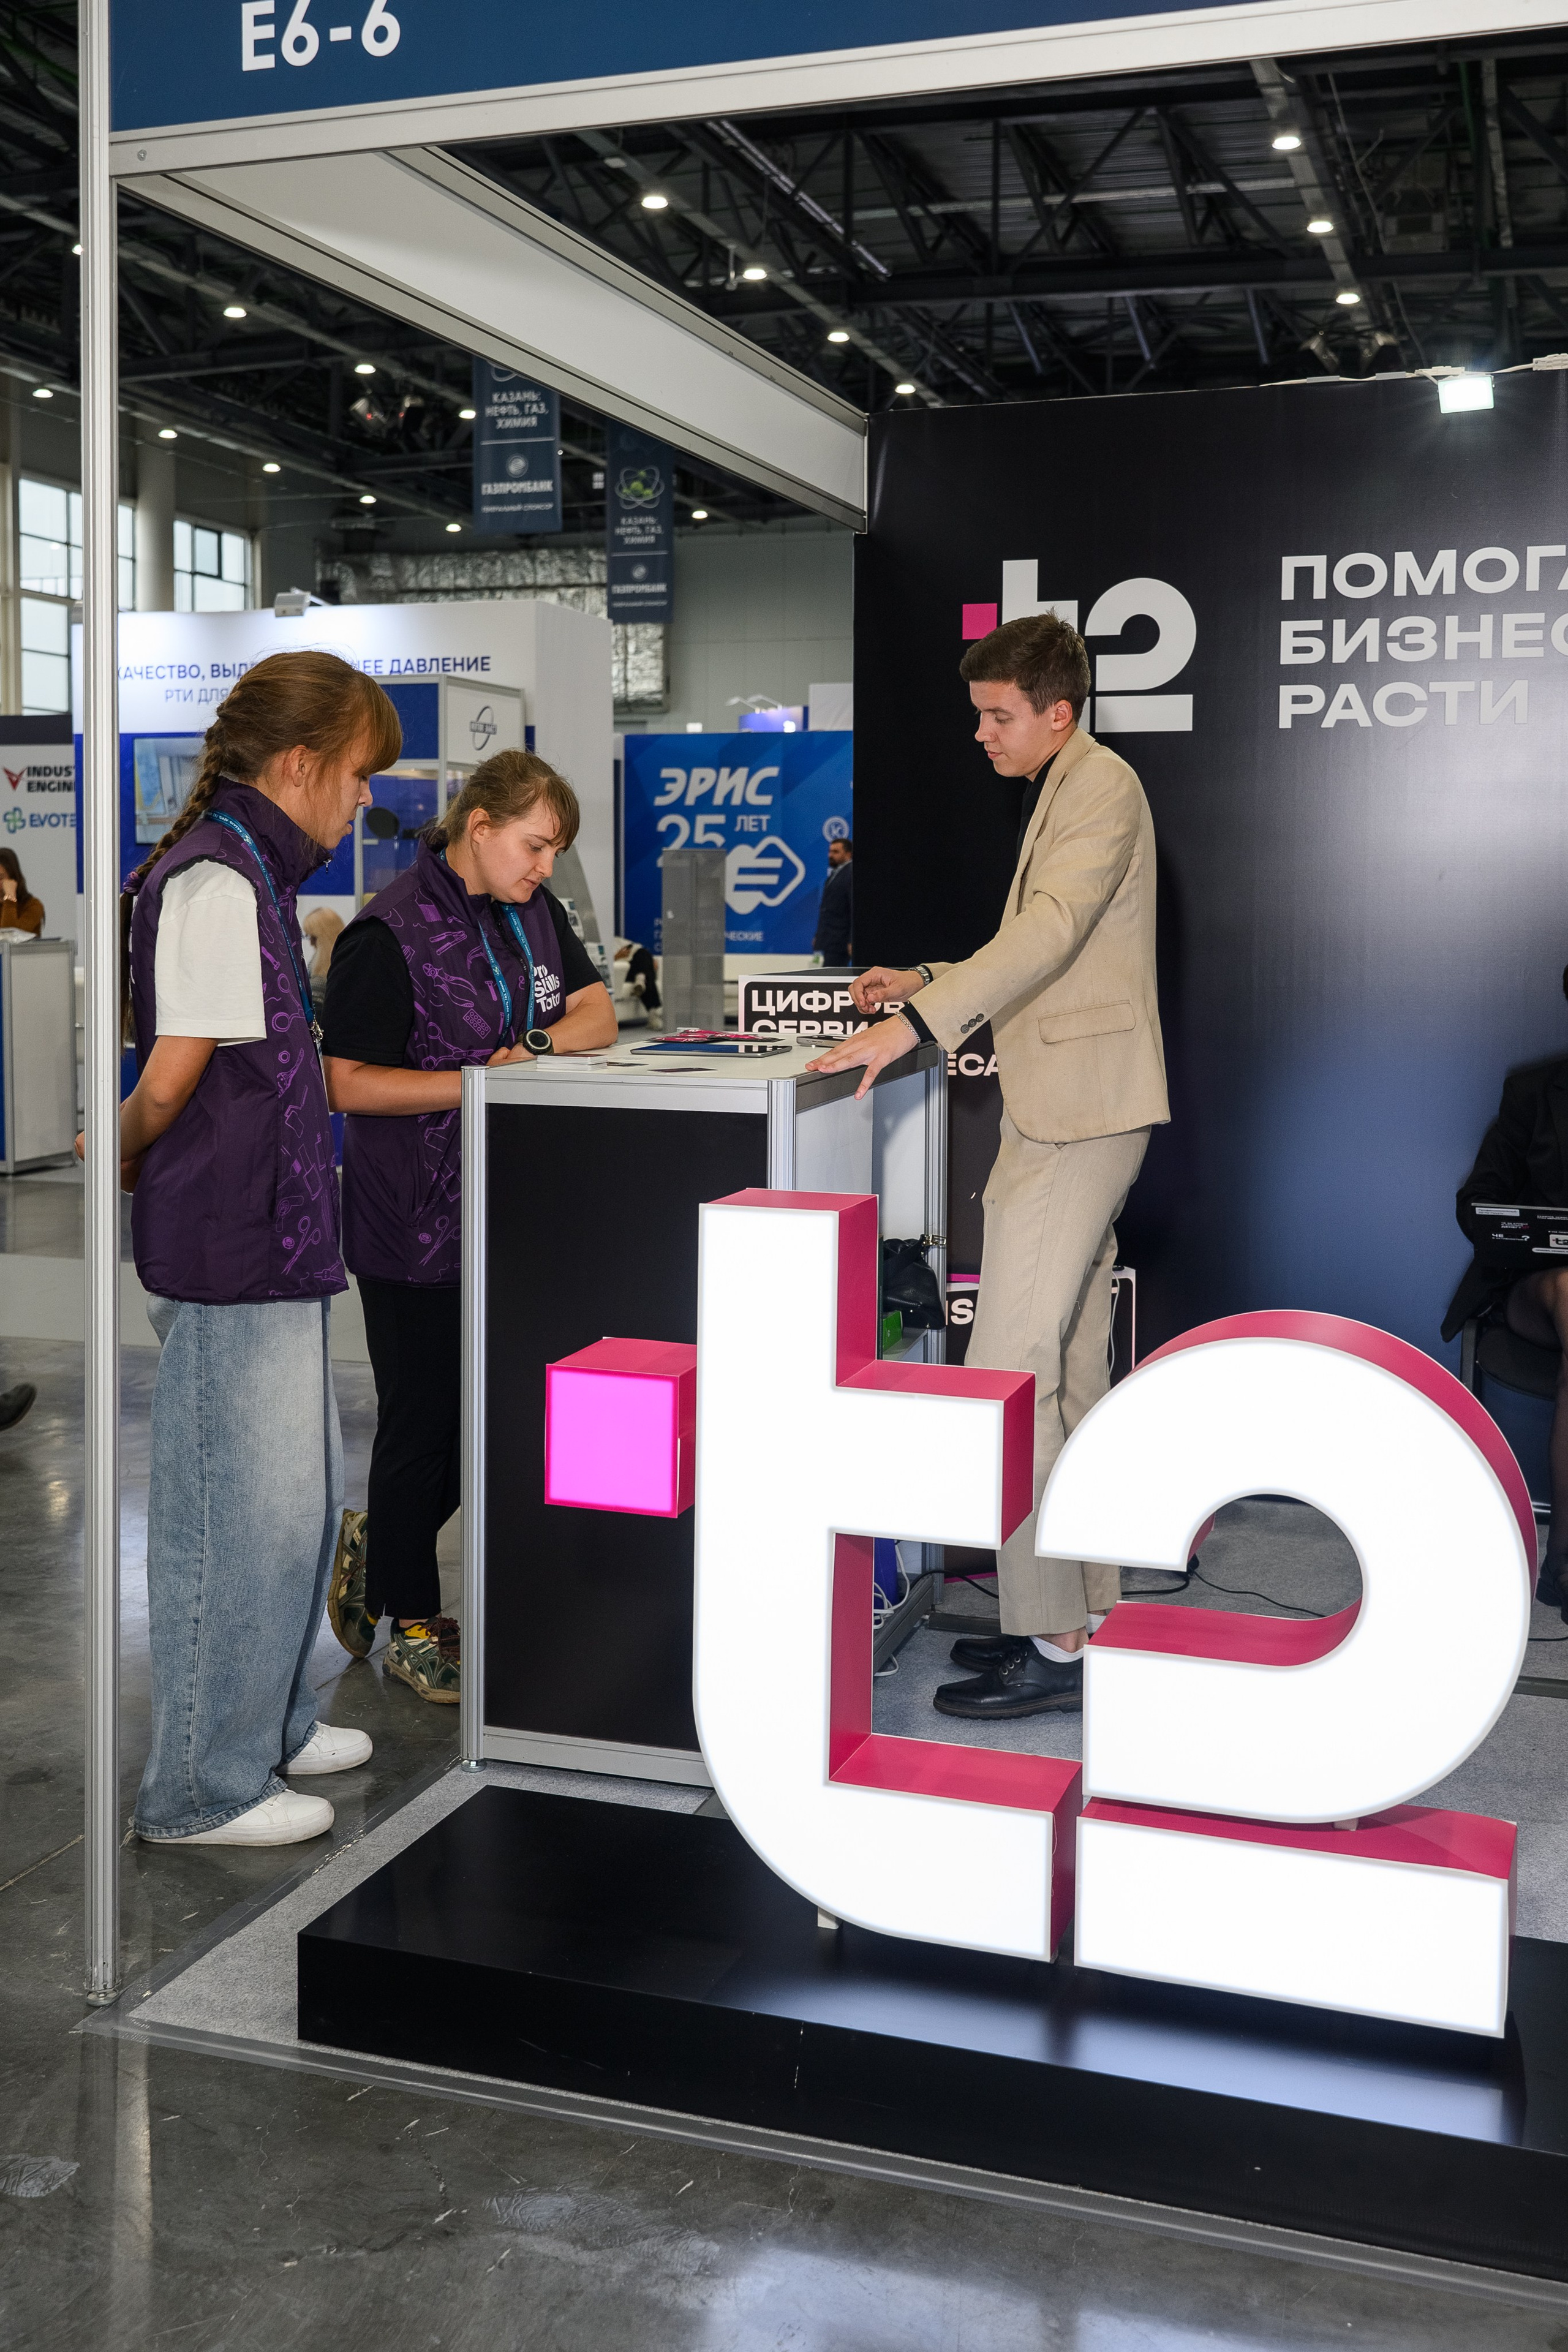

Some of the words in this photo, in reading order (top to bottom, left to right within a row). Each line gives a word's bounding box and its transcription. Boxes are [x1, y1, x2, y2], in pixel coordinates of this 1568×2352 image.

[242, 0, 401, 72] E6-6
[1281, 545, 1568, 600] ПОМОГ
[389, 656, 491, 675] ДАВЛЕНИЕ
[164, 688, 194, 703] РТИ
[1279, 680, 1529, 729] РАСТИ
[27, 766, 75, 777] INDUS
[27, 781, 75, 793] ENGIN
[654, 767, 780, 806] ЭРИС
[734, 815, 771, 832] ЛЕТ
[534, 974, 560, 998] Skills
[693, 1189, 1537, 2038] t2
